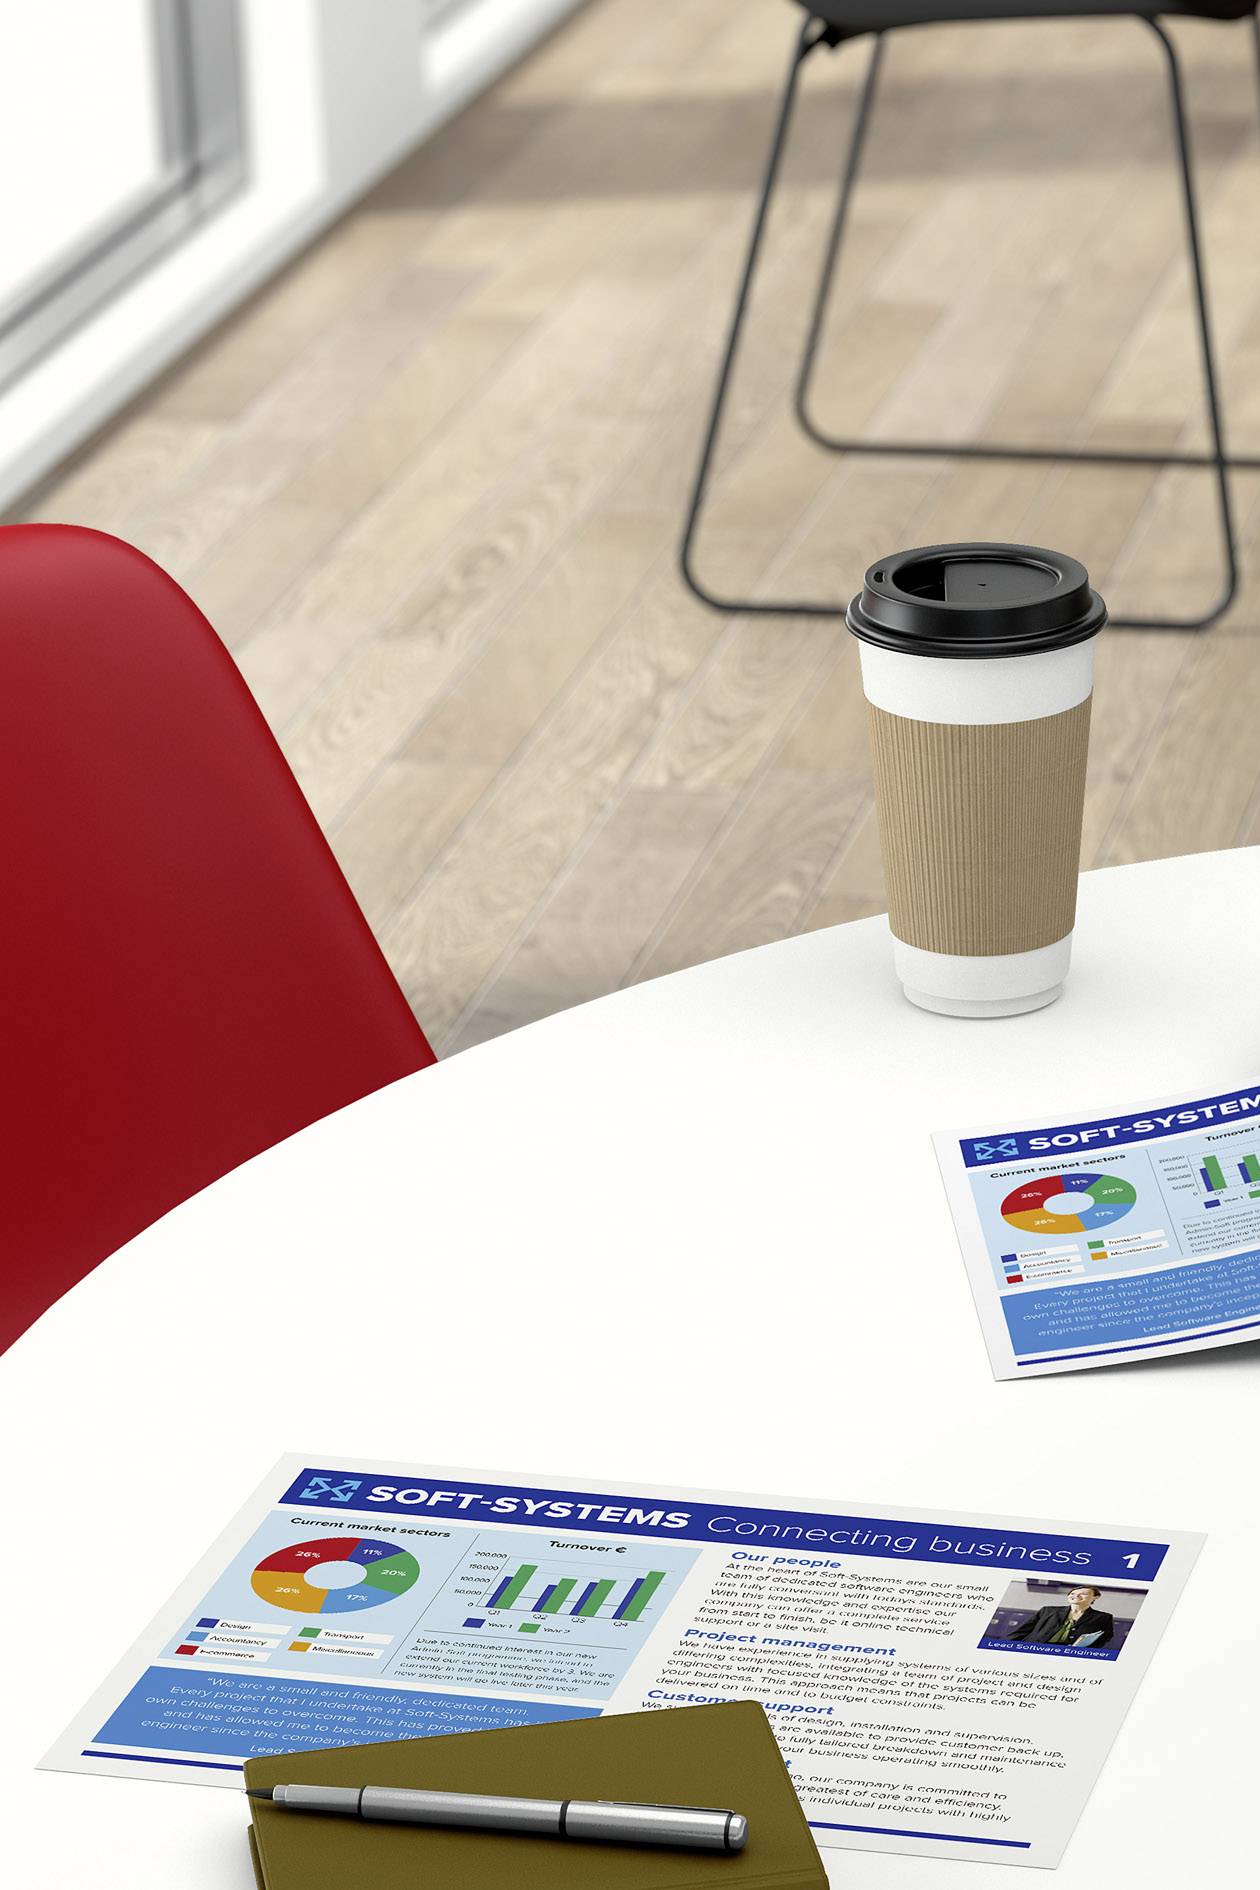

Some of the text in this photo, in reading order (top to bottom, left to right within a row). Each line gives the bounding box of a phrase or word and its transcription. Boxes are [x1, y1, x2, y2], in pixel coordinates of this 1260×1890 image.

[1206, 1127, 1254, 1141] Turnover
[990, 1155, 1125, 1178] Current market sectors
[291, 1518, 451, 1538] Current market sectors
[368, 1487, 1140, 1568] SOFT-SYSTEMS Connecting business 1
[295, 1550, 321, 1559] 26%
[363, 1548, 383, 1557] 11%
[550, 1541, 628, 1554] Turnover €
[732, 1552, 841, 1568] Our people
[380, 1569, 407, 1577] 20%
[725, 1562, 741, 1570] At
[742, 1564, 764, 1572] the
[766, 1566, 801, 1576] heart
[820, 1571, 902, 1584] Soft-Systems
[905, 1579, 928, 1587] are
[956, 1584, 990, 1593] small
[274, 1586, 301, 1594] 26%
[346, 1593, 369, 1602] 17%
[720, 1571, 995, 1603] team of dedicated software engineers who
[710, 1588, 958, 1618] With this knowledge and expertise our
[694, 1617, 743, 1626] support
[775, 1623, 799, 1632] site
[699, 1606, 728, 1615] from
[731, 1610, 761, 1619] start
[762, 1612, 777, 1620] to
[819, 1617, 838, 1626] be
[840, 1619, 850, 1627] it
[851, 1621, 893, 1631] online
[896, 1625, 954, 1635] technical
[685, 1629, 896, 1655] Project management
[987, 1640, 1109, 1657] Lead Software Engineer
[237, 1681, 263, 1691] are
[265, 1684, 276, 1692] a
[278, 1686, 319, 1696] small
[319, 1690, 351, 1699] and
[413, 1698, 487, 1711] dedicated
[661, 1668, 692, 1676] your
[761, 1676, 786, 1685] This
[790, 1681, 853, 1691] approach
[856, 1686, 901, 1696] means
[904, 1690, 931, 1699] that
[933, 1694, 986, 1704] projects
[990, 1699, 1016, 1707] can
[1018, 1700, 1037, 1709] be
[170, 1686, 531, 1727] Every project that I undertake at Soft-Systems has
[778, 1725, 802, 1733] are
[805, 1729, 864, 1738] available
[867, 1732, 882, 1741] to
[885, 1736, 936, 1745] provide
[941, 1741, 1004, 1751] customer
[1006, 1746, 1041, 1756] back
[808, 1775, 1008, 1801] our company is committed to
